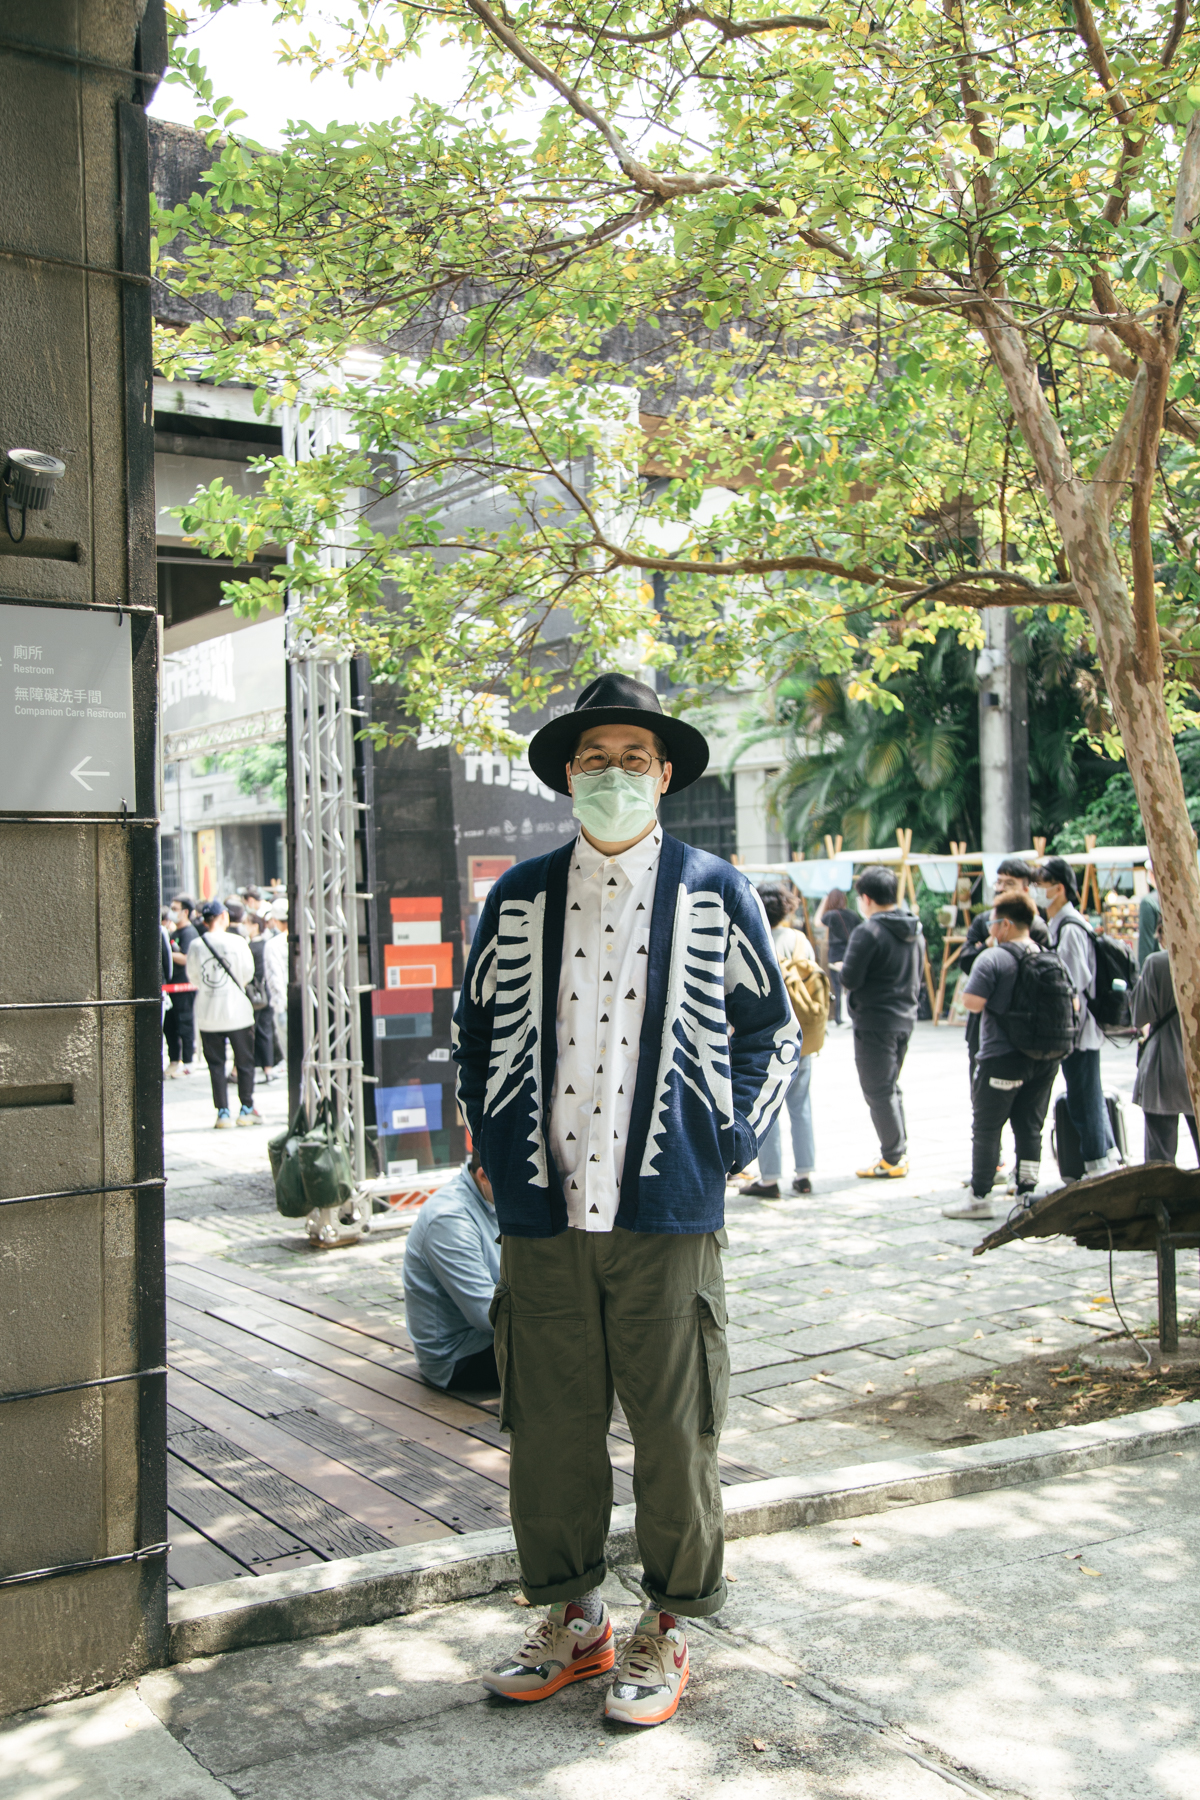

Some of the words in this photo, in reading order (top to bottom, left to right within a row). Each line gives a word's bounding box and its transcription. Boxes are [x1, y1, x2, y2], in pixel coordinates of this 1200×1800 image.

[13, 644, 43, 661] 廁所
[13, 664, 54, 675] Restroom
[14, 686, 102, 705] 無障礙洗手間
[14, 705, 63, 718] Companion
[65, 707, 85, 717] Care
[86, 708, 127, 719] Restroom
